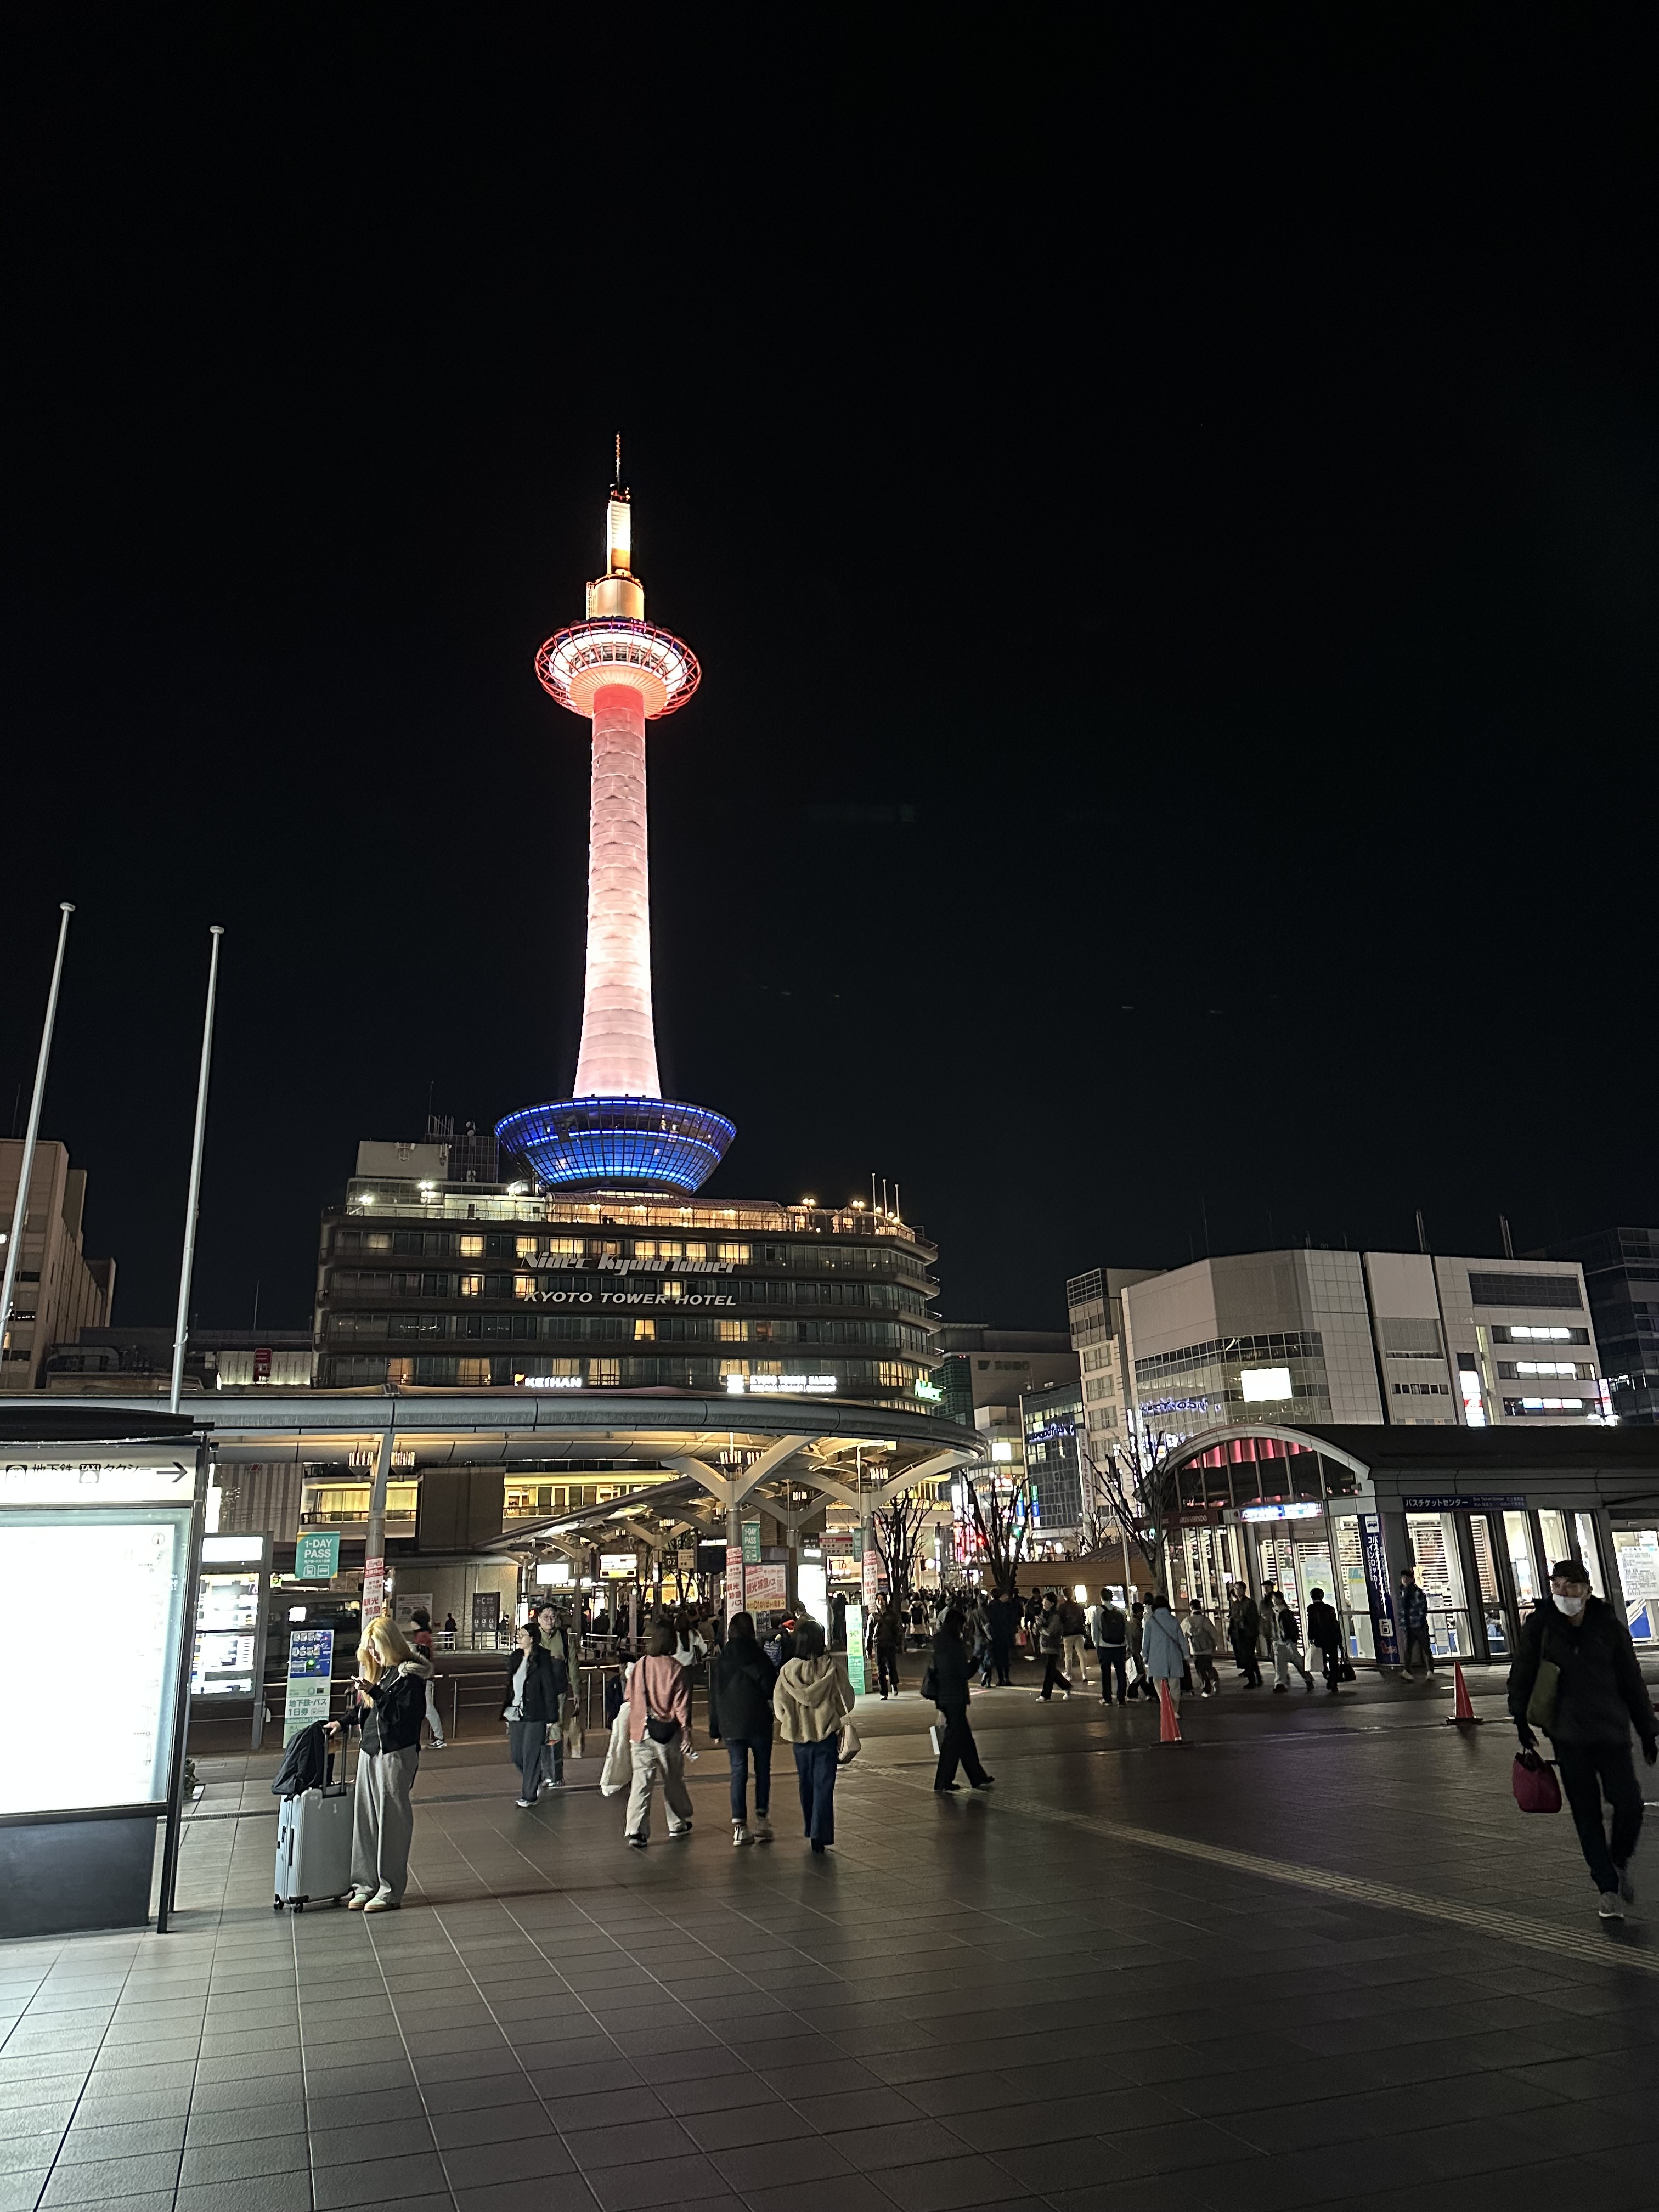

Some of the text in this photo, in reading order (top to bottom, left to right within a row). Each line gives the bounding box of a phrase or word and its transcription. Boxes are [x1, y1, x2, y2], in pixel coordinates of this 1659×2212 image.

[521, 1251, 736, 1276] Nidec Kyoto Tower
[524, 1291, 736, 1306] KYOTO TOWER HOTEL
[1406, 1498, 1468, 1507] バスチケットセンター
[744, 1528, 757, 1536] 1-DAY
[304, 1539, 332, 1548] 1-DAY
[744, 1536, 757, 1544] PASS
[304, 1549, 331, 1558] PASS
[1367, 1536, 1378, 1590] コインロッカー
[363, 1596, 379, 1606] 観光
[365, 1606, 381, 1615] 特急
[289, 1698, 326, 1707] 地下鉄・バス
